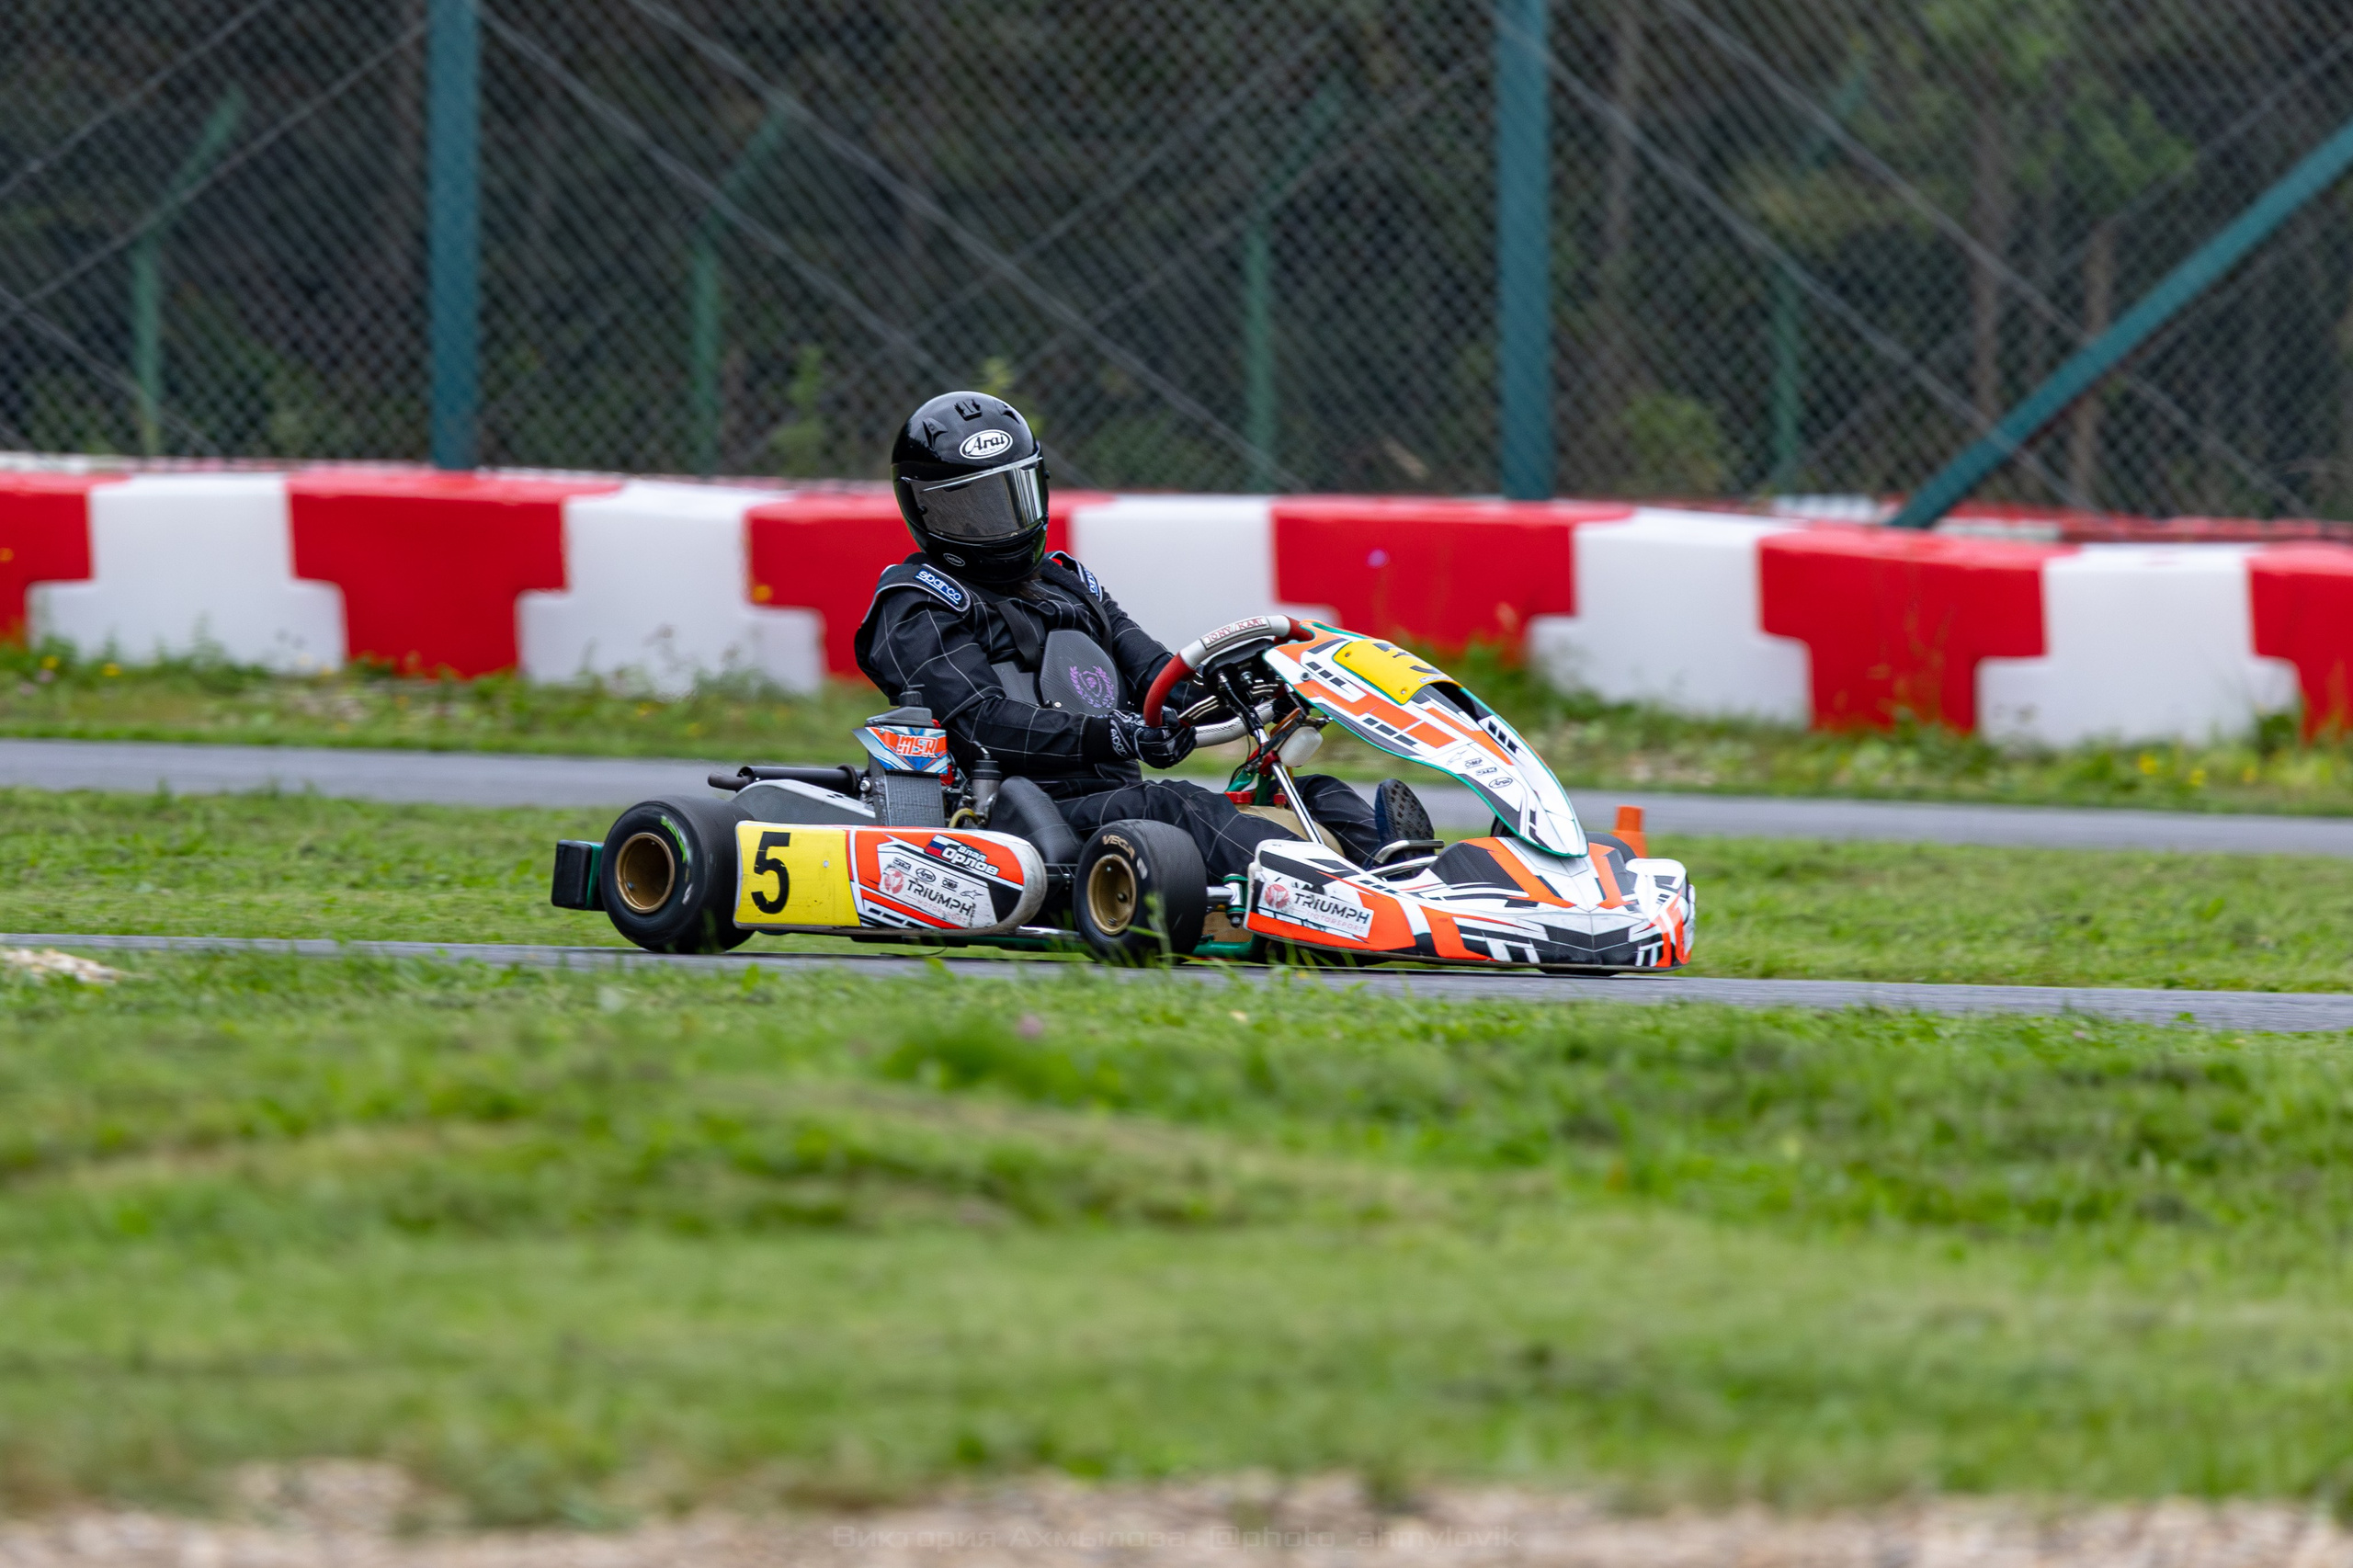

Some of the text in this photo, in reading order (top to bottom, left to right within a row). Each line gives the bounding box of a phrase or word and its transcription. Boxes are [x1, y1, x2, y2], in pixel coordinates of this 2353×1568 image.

[965, 433, 1005, 455] Arai
[918, 570, 961, 601] sparco
[896, 735, 937, 756] MSR
[957, 845, 988, 863] Влад
[1102, 835, 1135, 859] VEGA
[751, 831, 791, 915] 5
